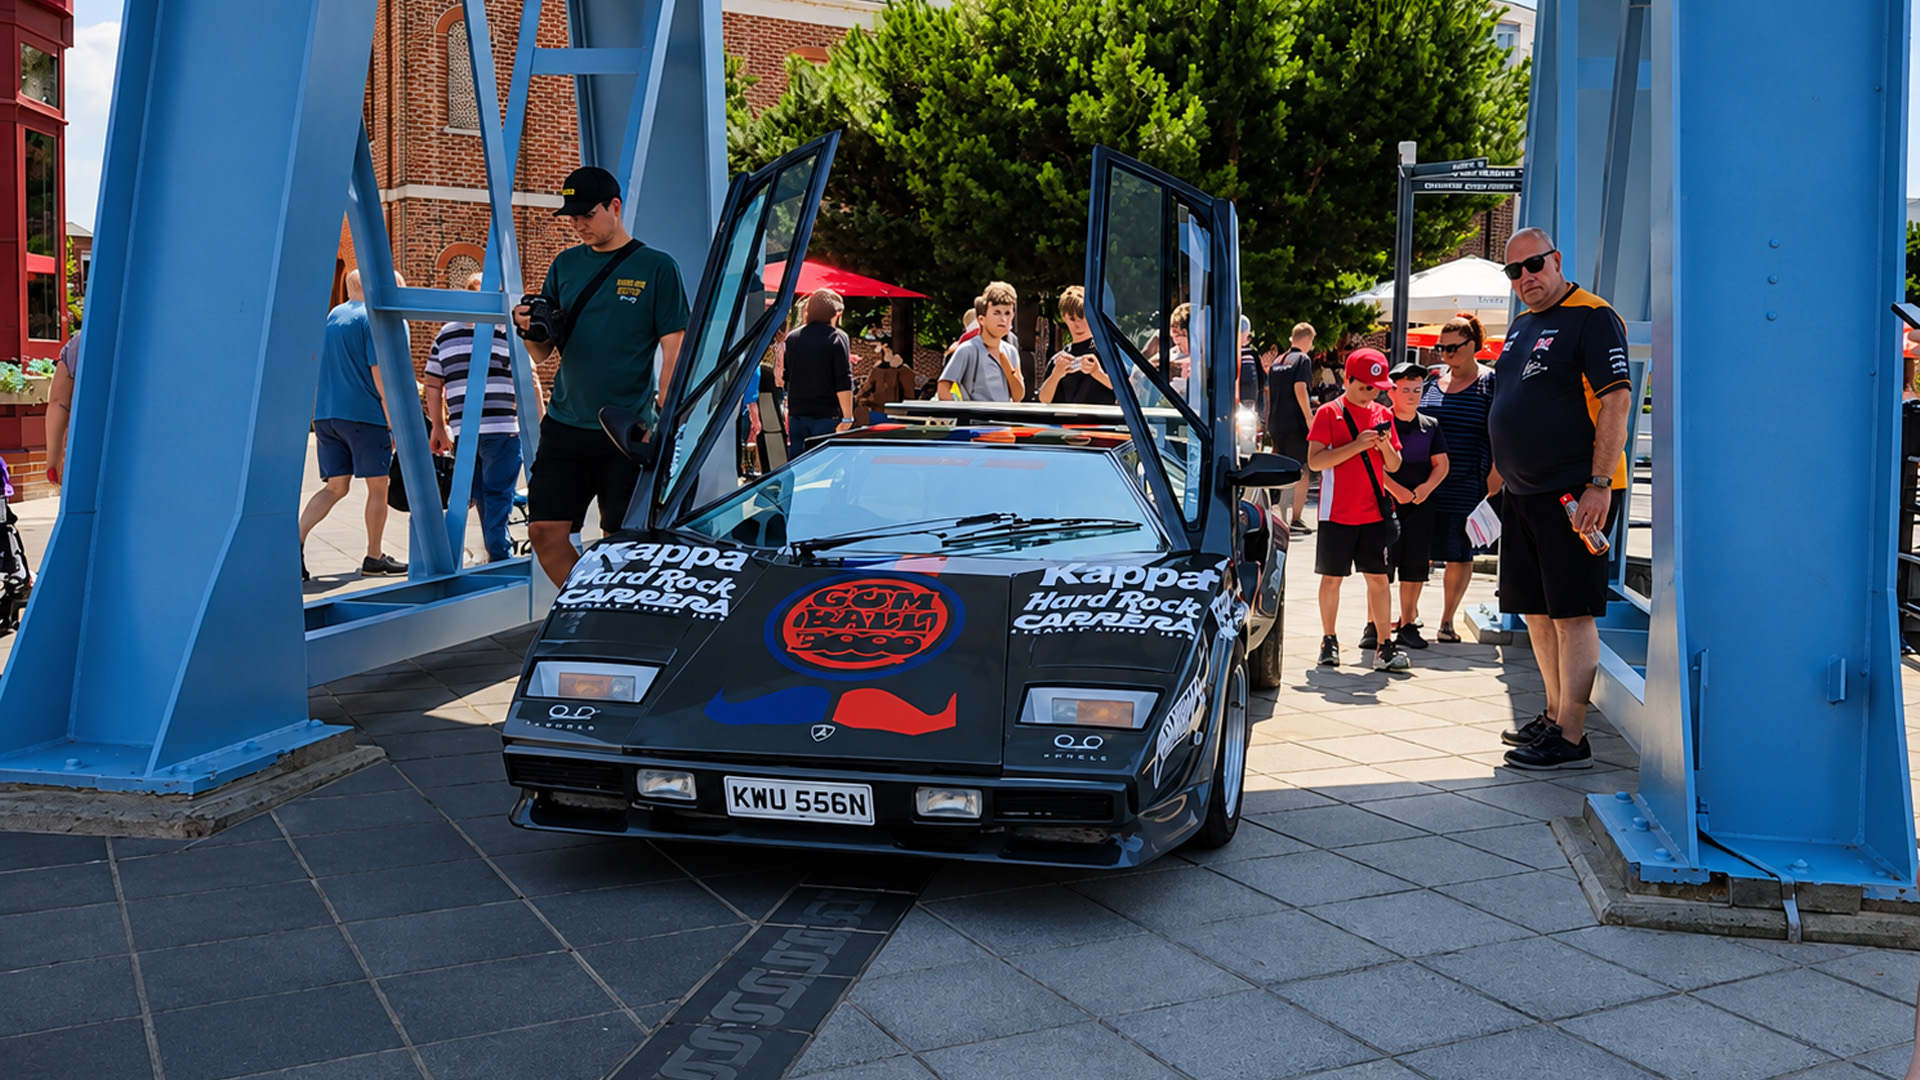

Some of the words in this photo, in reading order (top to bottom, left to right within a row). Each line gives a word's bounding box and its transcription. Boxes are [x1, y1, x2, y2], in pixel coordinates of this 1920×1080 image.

[591, 541, 749, 571] Kappa
[566, 567, 659, 589] Hard
[651, 569, 737, 598] Rock
[556, 588, 729, 616] CARRERA
[1023, 589, 1117, 611] Hard
[1115, 591, 1202, 619] Rock
[1013, 611, 1196, 635] CARRERA
[732, 786, 787, 810] KWU
[795, 790, 867, 816] 556N
